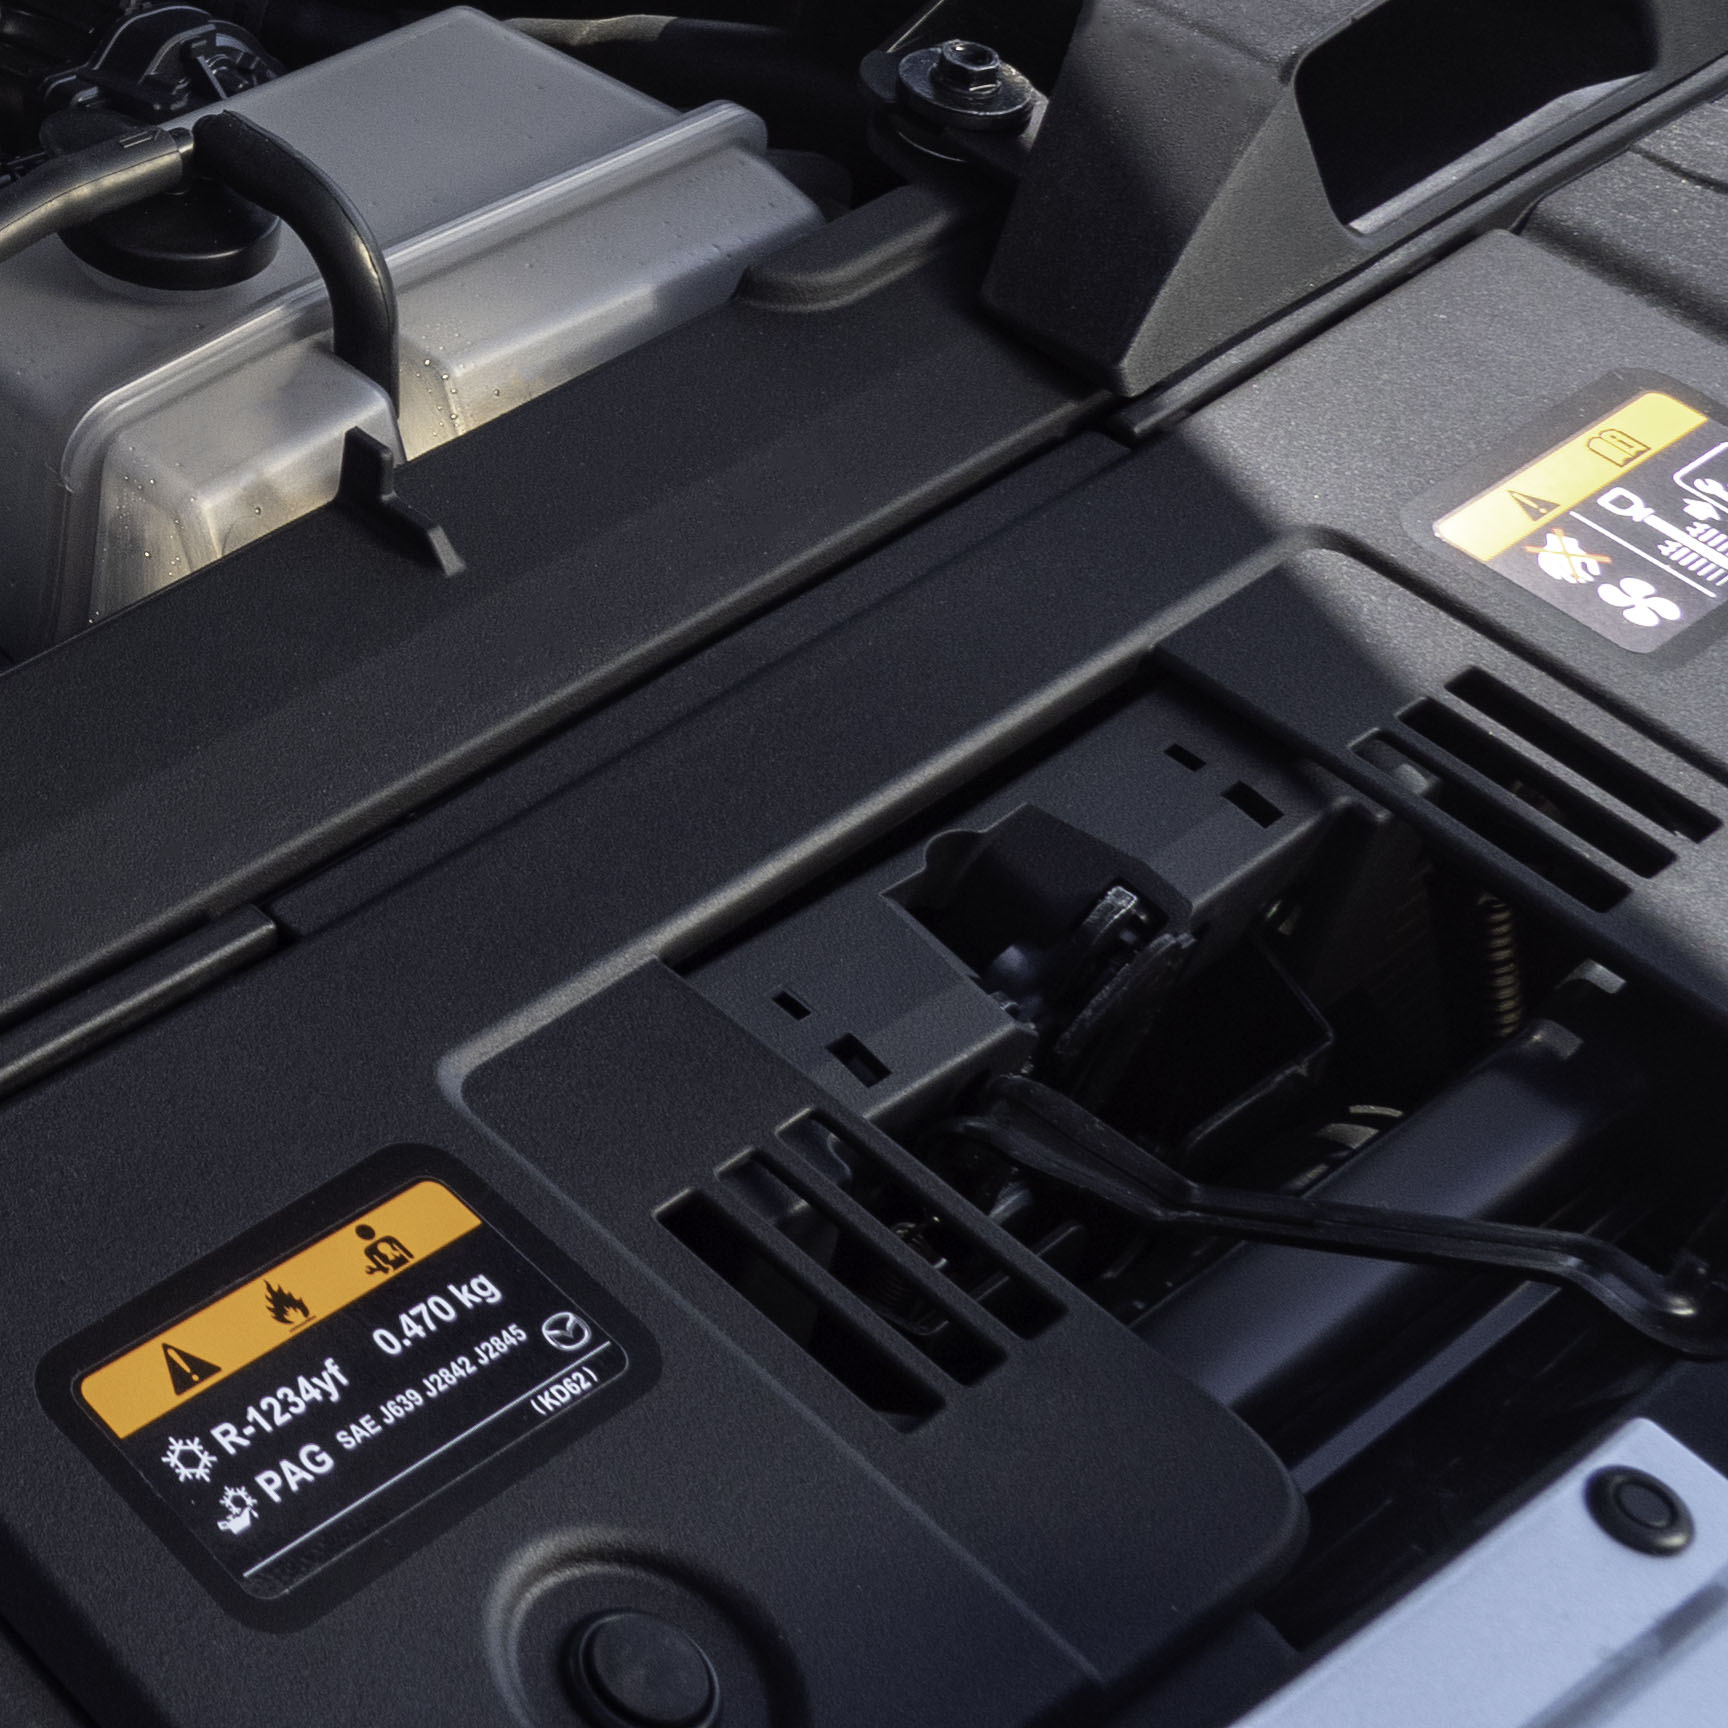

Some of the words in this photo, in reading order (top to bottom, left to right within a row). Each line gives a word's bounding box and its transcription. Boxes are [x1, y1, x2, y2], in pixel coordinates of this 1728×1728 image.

[210, 1357, 350, 1456] R-1234yf
[372, 1294, 458, 1357] 0.470
[447, 1273, 504, 1305] kg
[254, 1443, 335, 1505] PAG
[336, 1414, 384, 1451] SAE
[378, 1388, 425, 1427] J639
[422, 1355, 478, 1400] J2842
[473, 1322, 529, 1366] J2845
[529, 1365, 599, 1416] (KD62)
